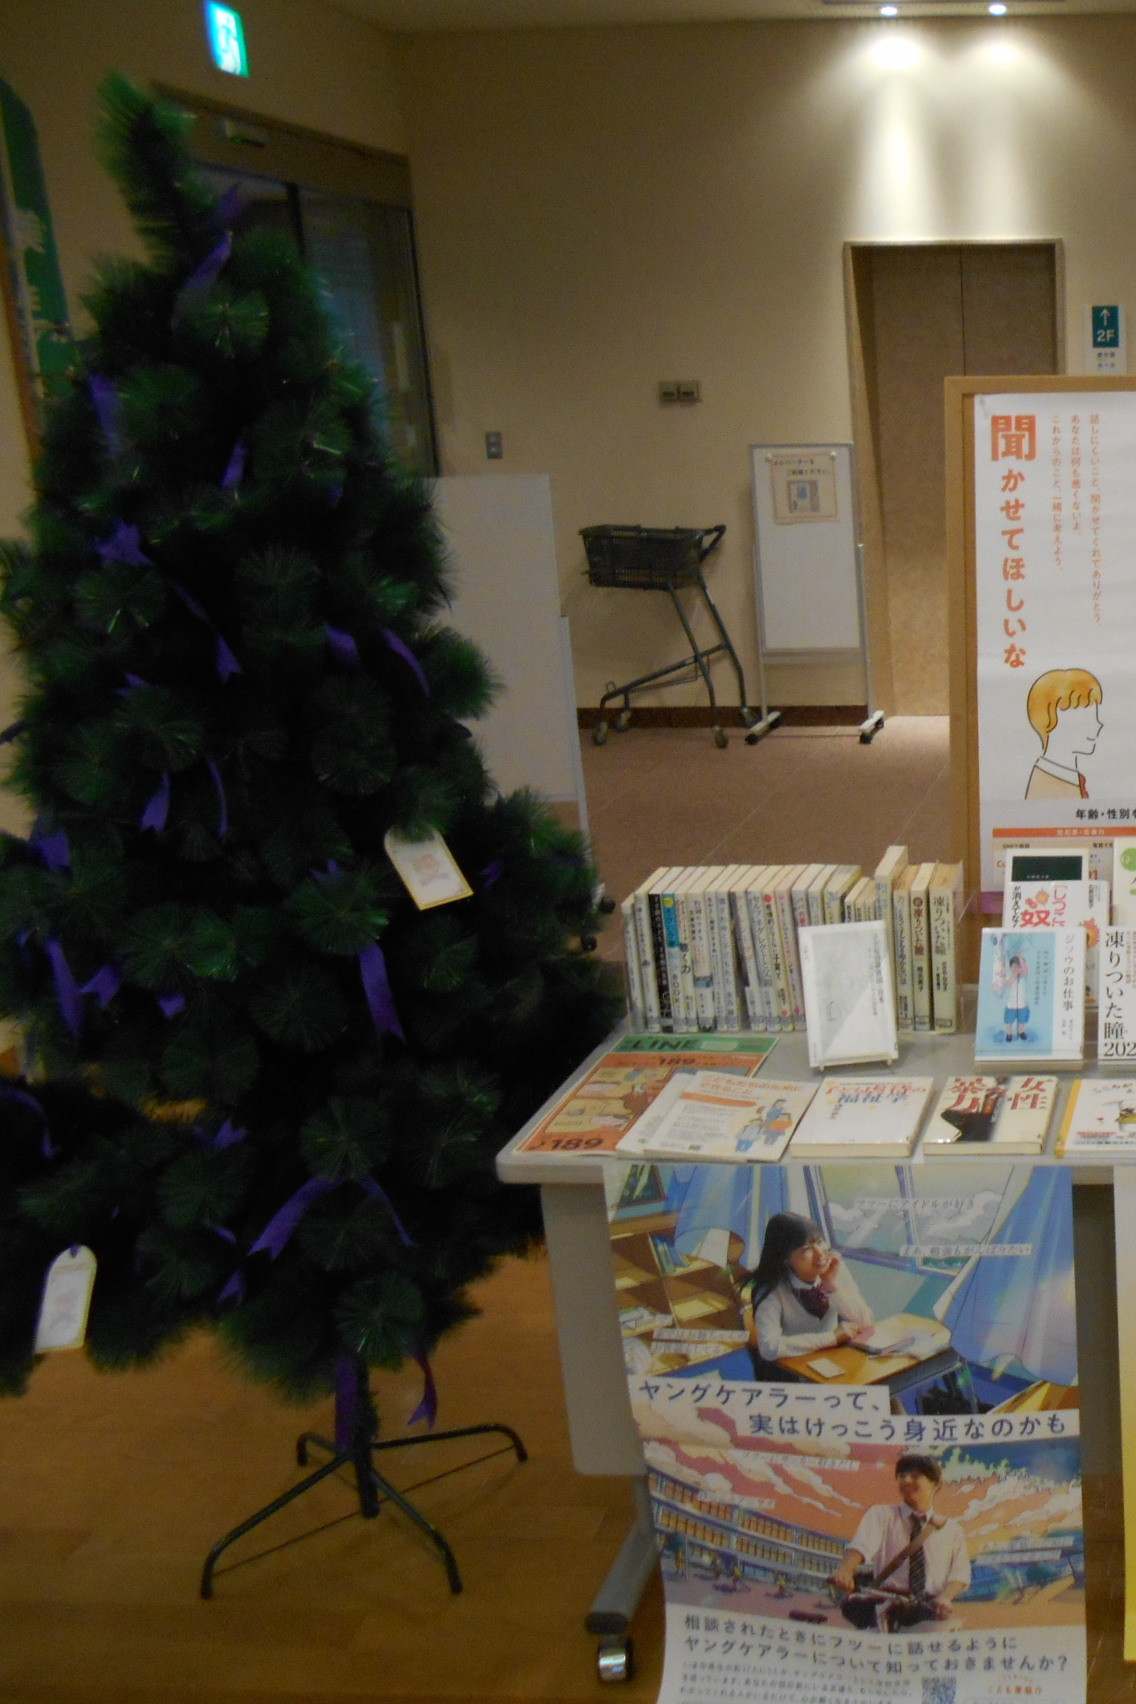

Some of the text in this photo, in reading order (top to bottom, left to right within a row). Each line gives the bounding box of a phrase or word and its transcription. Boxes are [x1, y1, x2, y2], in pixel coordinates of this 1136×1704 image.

[1096, 329, 1115, 342] 2F
[990, 414, 1037, 668] 聞かせてほしいな
[1103, 930, 1126, 1039] 凍りついた瞳
[631, 1038, 699, 1050] LINE
[639, 1379, 883, 1413] ヤングケアラーって、
[749, 1412, 1067, 1443] 実はけっこう身近なのかも
[685, 1614, 1018, 1656] 相談されたときにフツーに話せるように
